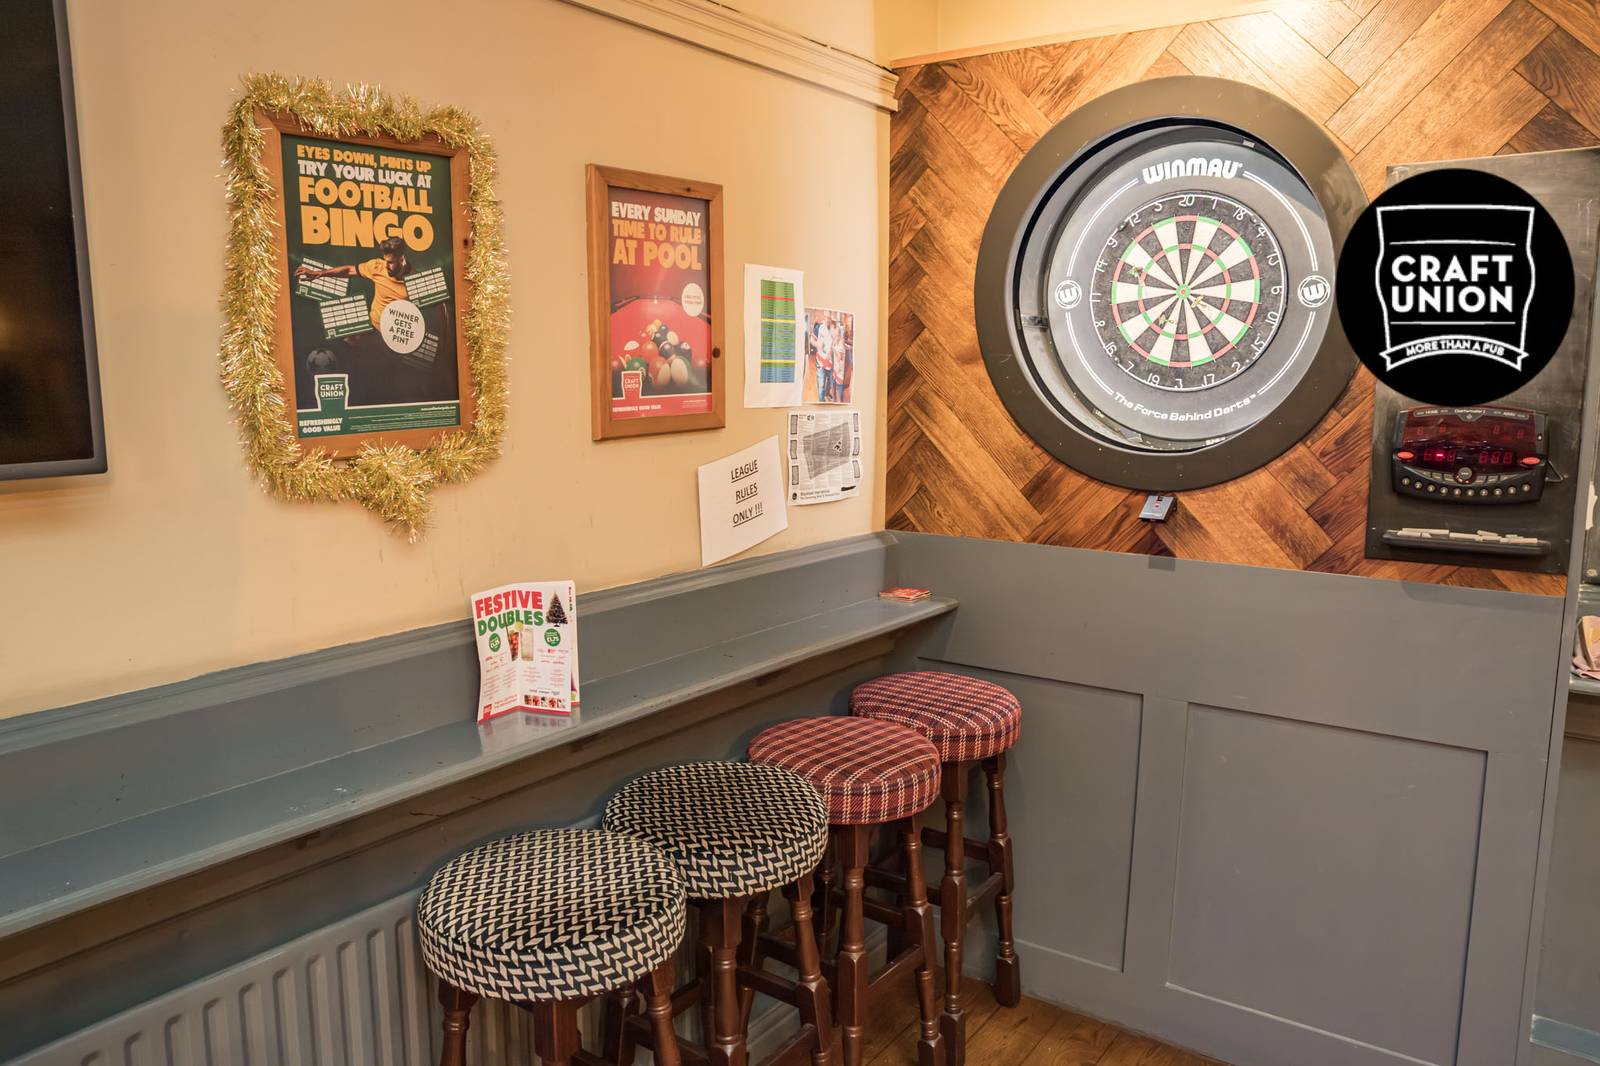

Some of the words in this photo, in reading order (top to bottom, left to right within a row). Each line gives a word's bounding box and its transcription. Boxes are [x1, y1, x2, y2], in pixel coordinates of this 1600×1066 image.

[297, 144, 331, 161] EYES
[333, 149, 377, 169] DOWN,
[380, 155, 414, 171] PINTS
[415, 160, 432, 173] UP
[298, 160, 328, 176] TRY
[332, 164, 375, 183] YOUR
[378, 169, 413, 187] LUCK
[416, 174, 432, 189] AT
[1142, 157, 1240, 185] WINMAU
[298, 176, 433, 214] FOOTBALL
[1178, 195, 1195, 207] 20
[611, 201, 651, 221] EVERY
[654, 206, 701, 227] SUNDAY
[1125, 213, 1141, 227] 12
[1233, 206, 1247, 220] 18
[300, 204, 434, 252] BINGO
[612, 218, 645, 239] TIME
[648, 222, 667, 241] TO
[670, 226, 702, 245] RULE
[613, 238, 638, 266] AT
[643, 241, 702, 271] POOL
[389, 308, 419, 324] WINNER
[394, 318, 413, 330] GETS
[1265, 311, 1280, 326] 10
[389, 326, 396, 334] A
[396, 327, 415, 339] FREE
[392, 335, 410, 346] PINT
[320, 390, 344, 398] UNION
[1113, 391, 1134, 409] The
[1134, 403, 1168, 420] Force
[1169, 409, 1213, 422] Behind
[322, 424, 341, 432] VALUE
[731, 459, 759, 481] LEAGUE
[735, 482, 758, 502] RULES
[732, 507, 754, 525] ONLY
[475, 590, 543, 619] FESTIVE
[477, 610, 544, 636] DOUBLES
